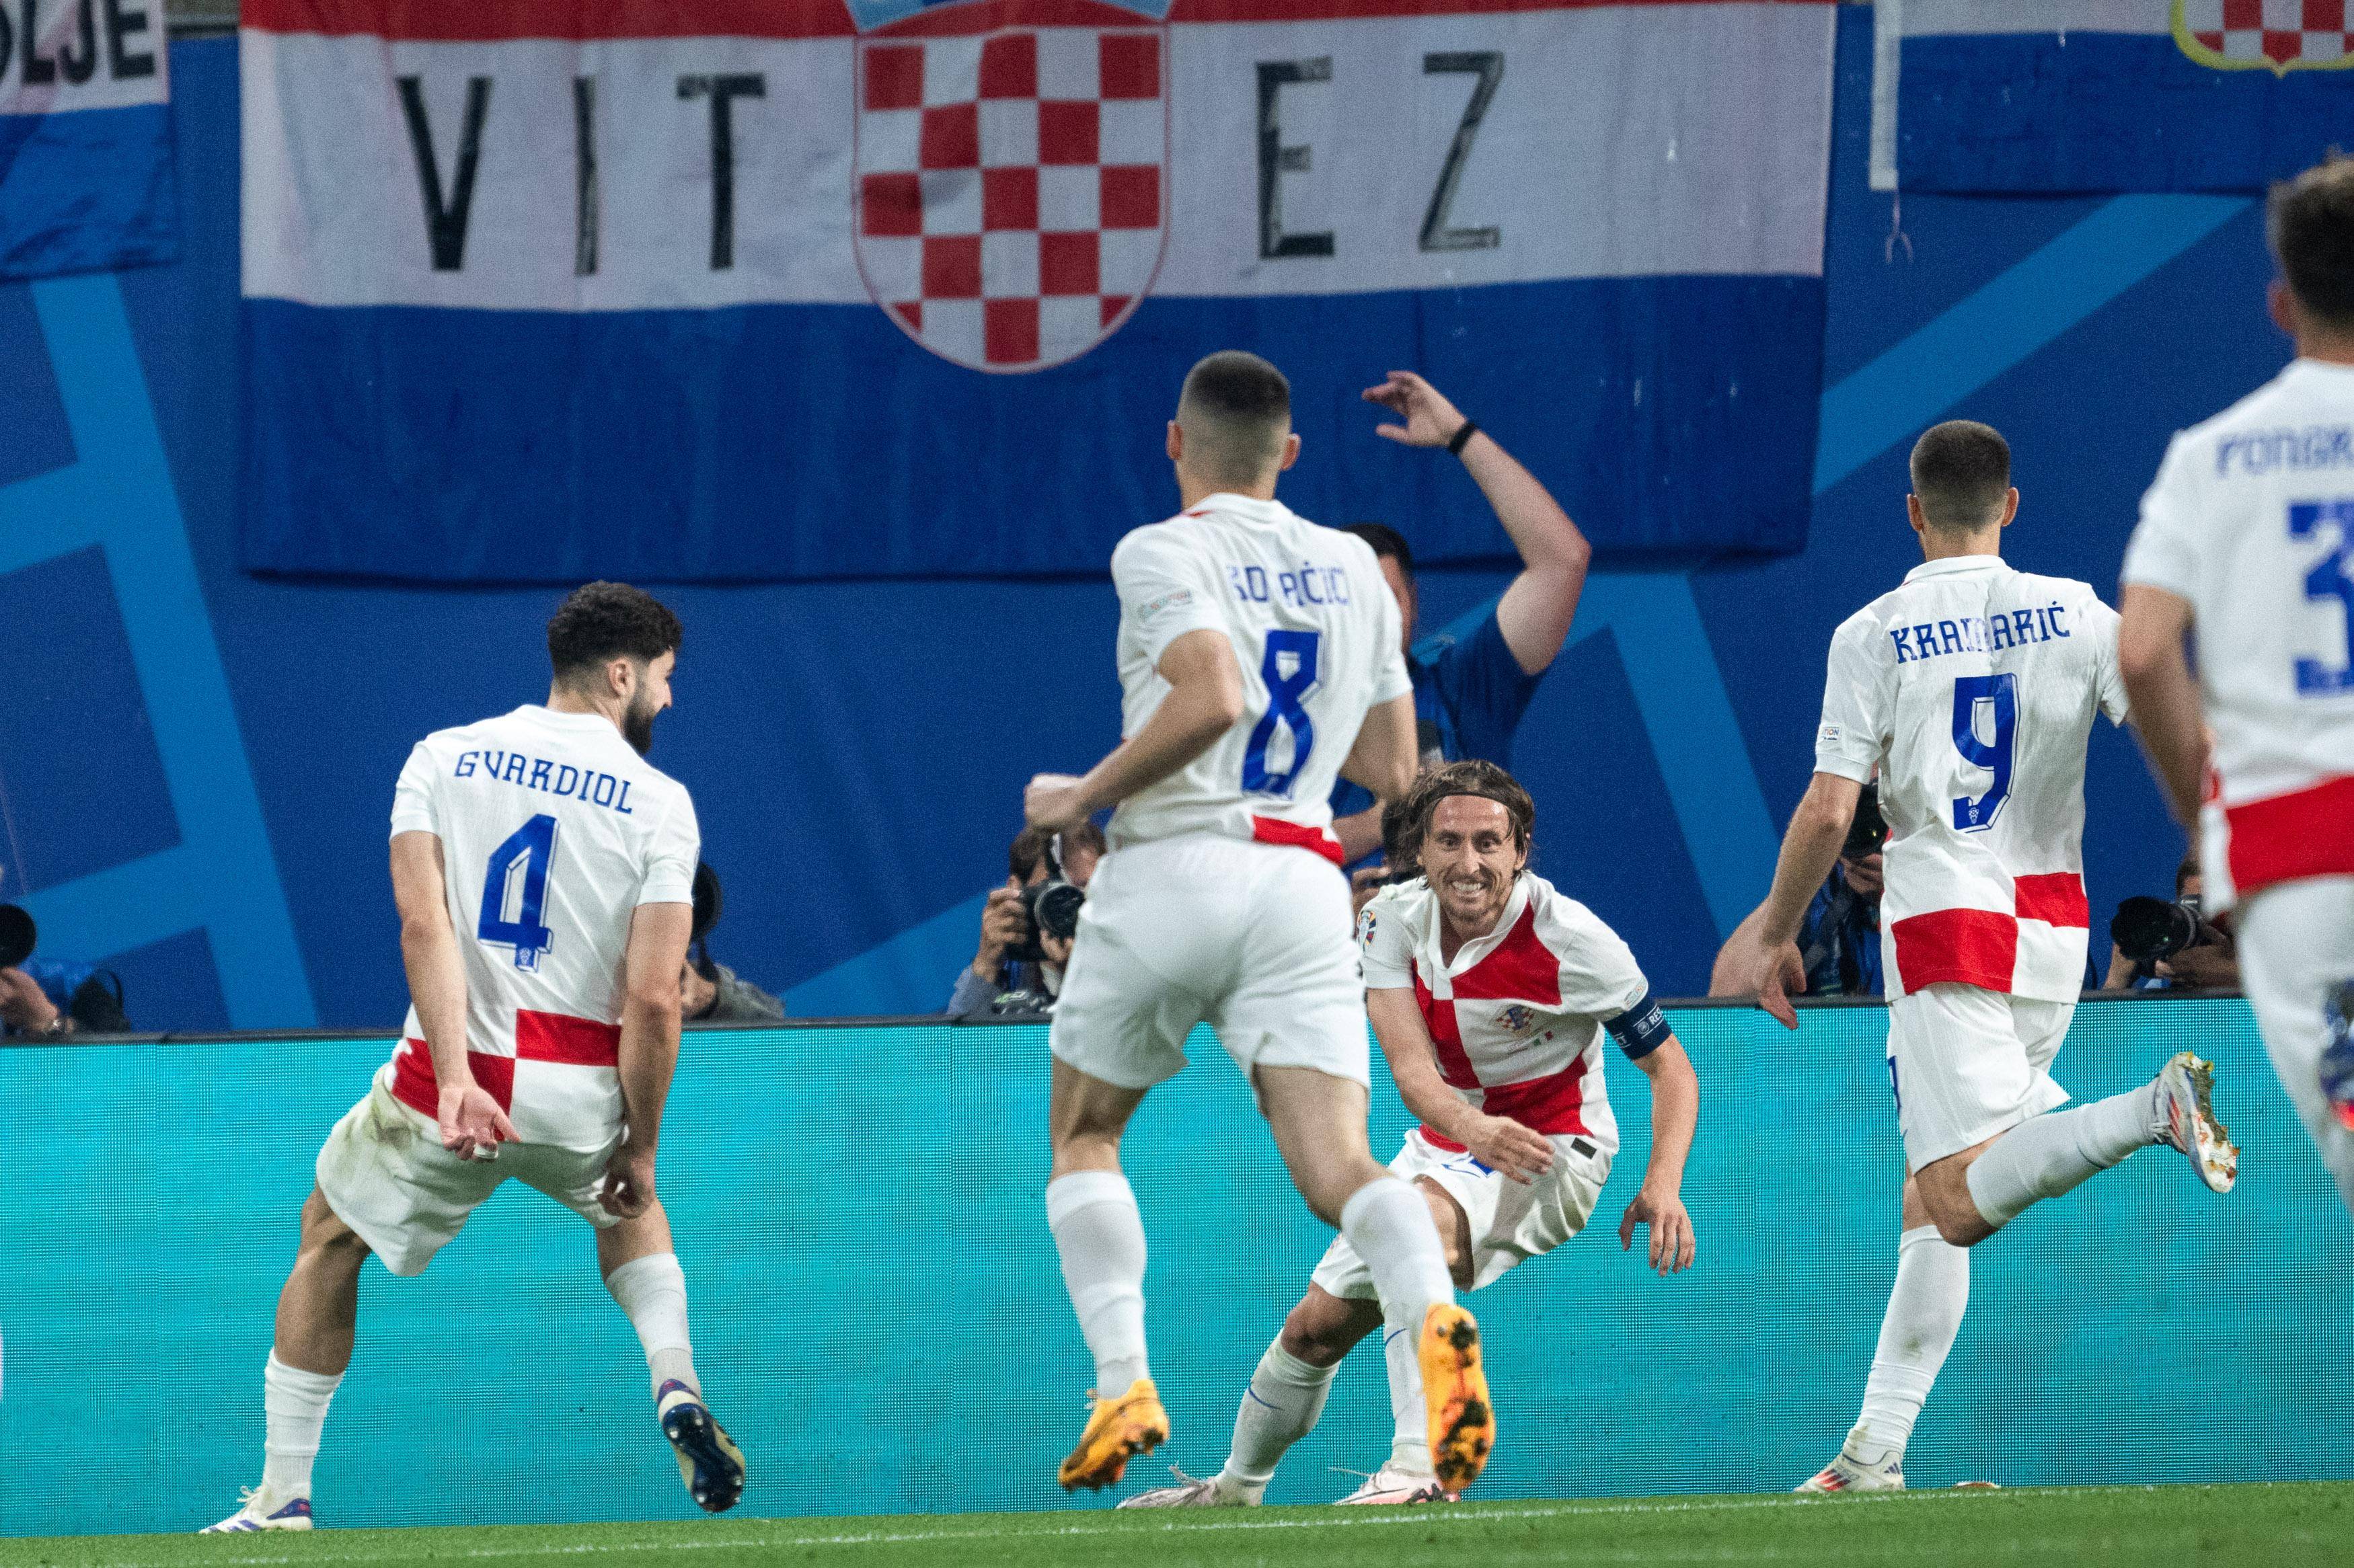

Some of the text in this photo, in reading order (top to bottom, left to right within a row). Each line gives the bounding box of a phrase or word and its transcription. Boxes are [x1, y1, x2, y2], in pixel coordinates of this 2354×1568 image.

[2287, 498, 2354, 698] 3
[454, 750, 633, 814] GVARDIOL
[1241, 629, 1323, 800] 8
[1952, 672, 2020, 833] 9
[478, 813, 560, 973] 4
